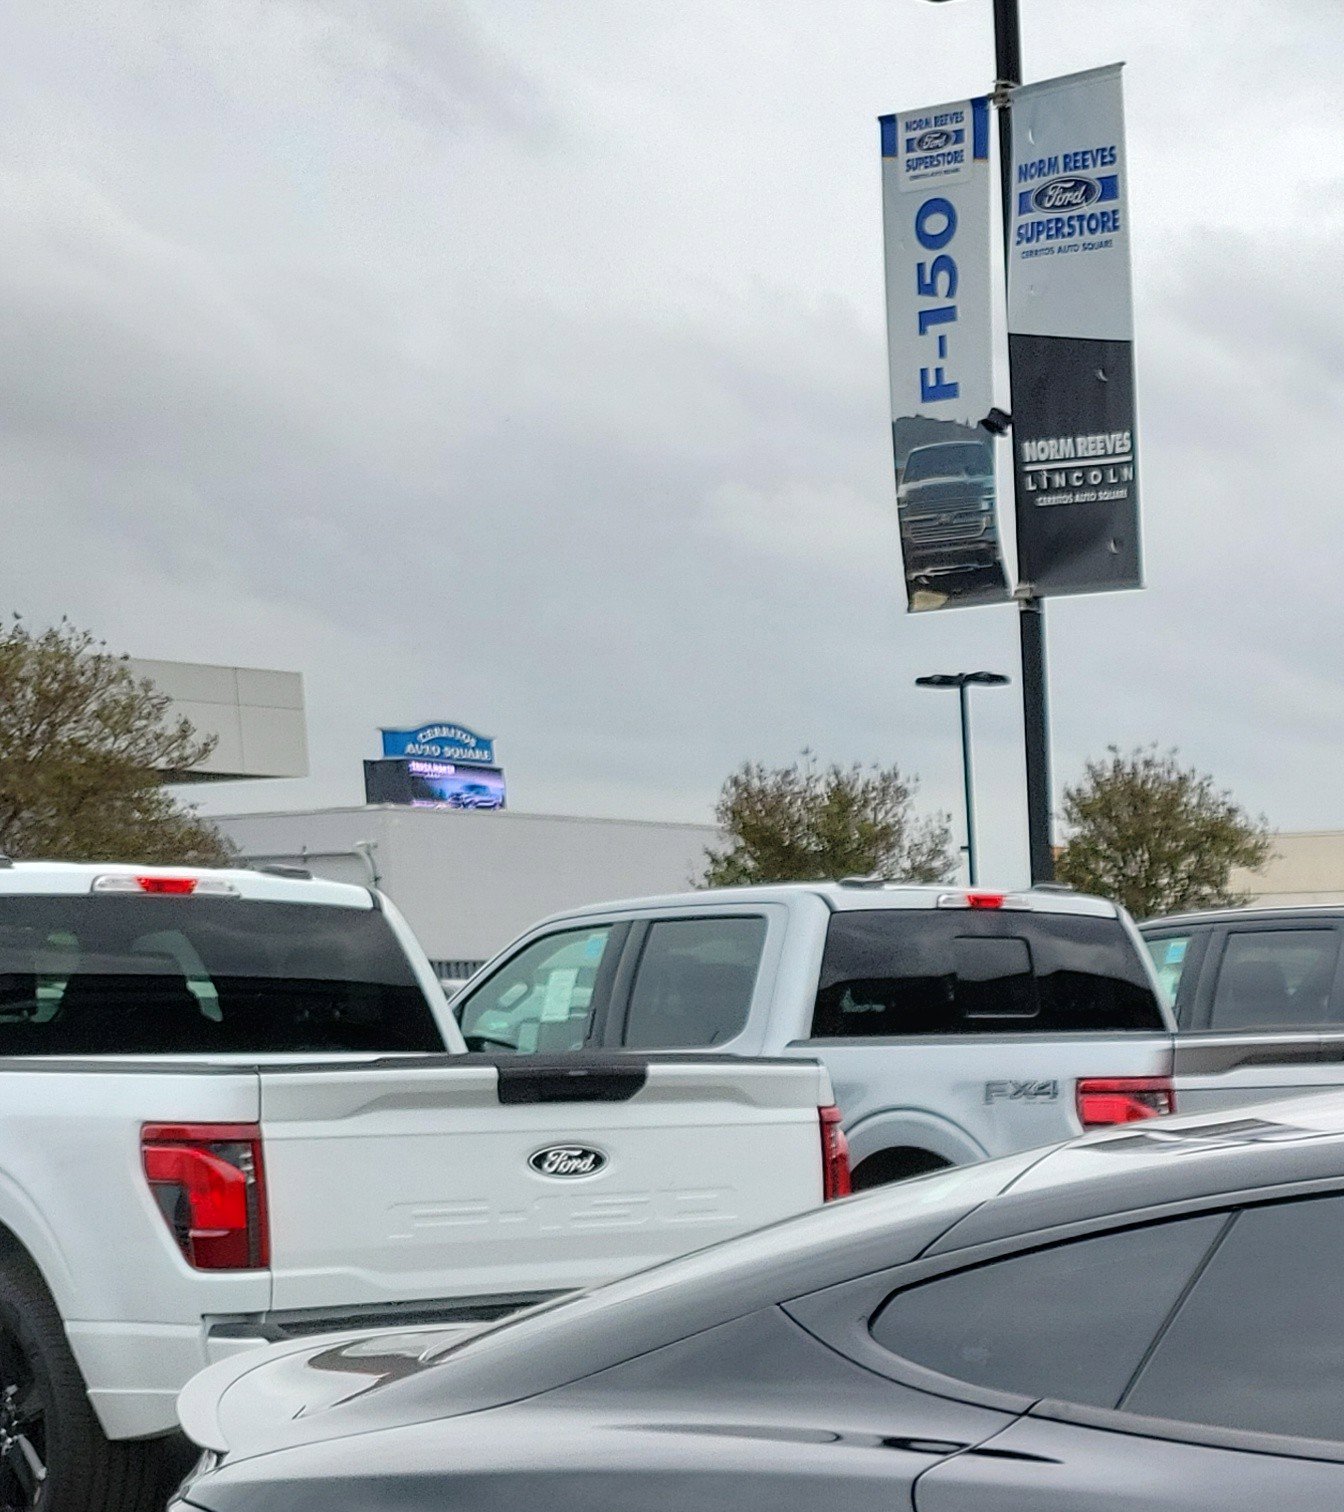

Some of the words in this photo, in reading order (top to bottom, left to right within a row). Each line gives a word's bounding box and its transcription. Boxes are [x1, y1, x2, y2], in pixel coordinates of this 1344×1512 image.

[905, 150, 964, 172] SUPERSTORE
[1018, 156, 1059, 183] NORM
[1063, 145, 1117, 172] REEVES
[1045, 181, 1087, 208] Ford
[1015, 209, 1120, 246] SUPERSTORE
[915, 197, 959, 404] F-150
[1023, 437, 1075, 462] NORM
[1076, 432, 1132, 457] REEVES
[1026, 464, 1133, 491] LINCOLN
[417, 726, 477, 747] CERRITOS
[406, 742, 440, 757] AUTO
[443, 746, 490, 760] SQUARE
[984, 1078, 1058, 1105] FX4
[545, 1150, 597, 1174] Ford
